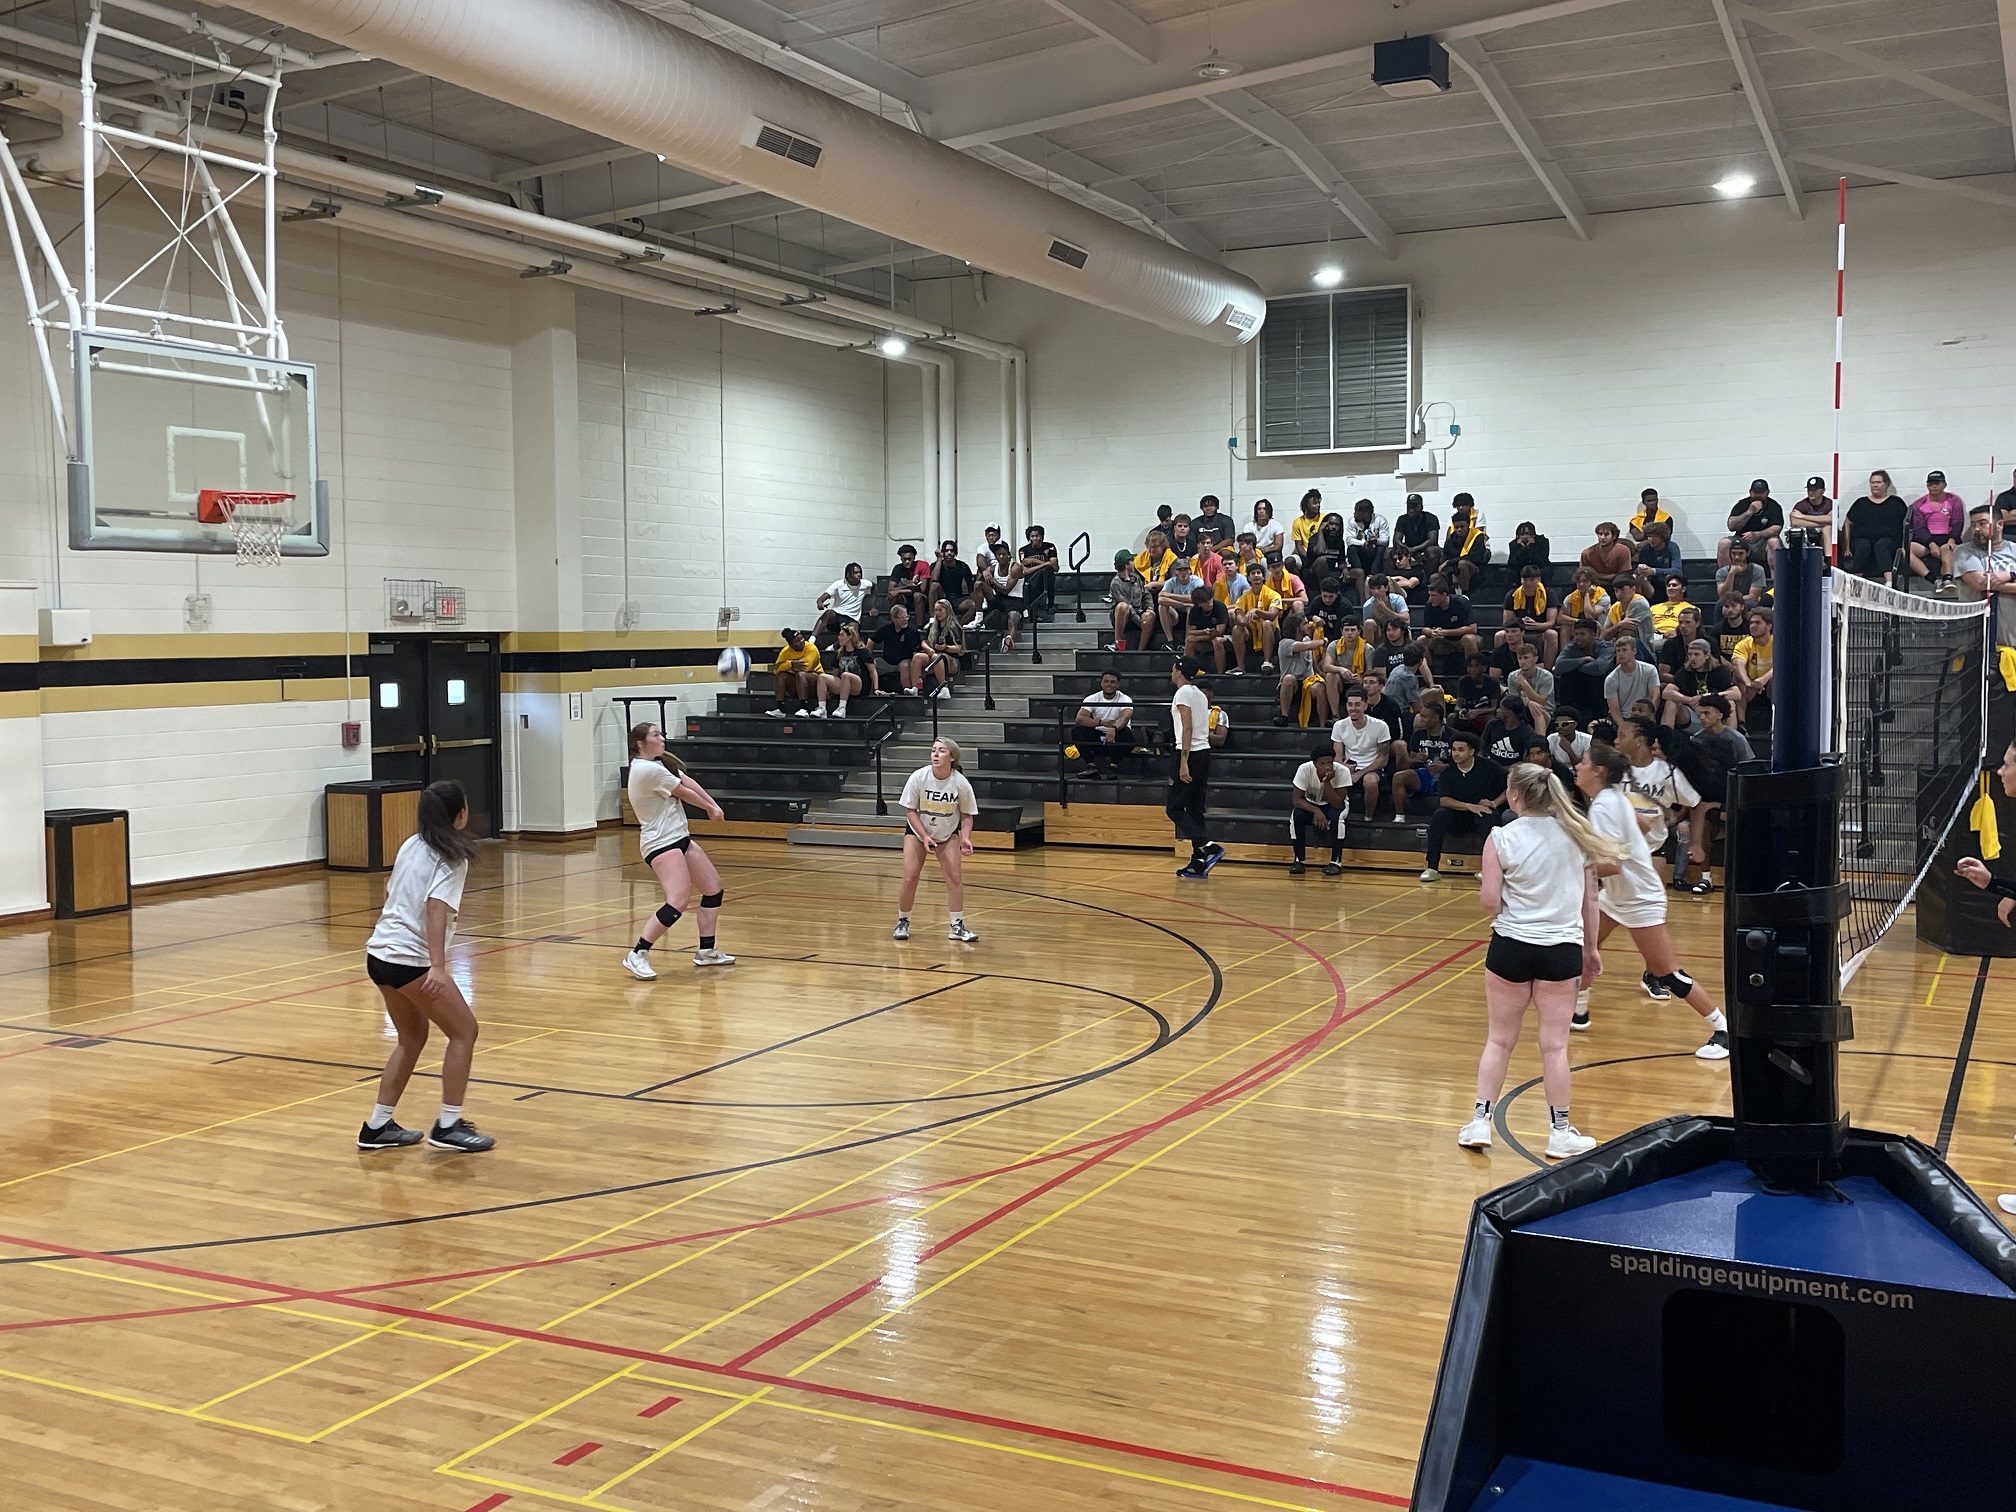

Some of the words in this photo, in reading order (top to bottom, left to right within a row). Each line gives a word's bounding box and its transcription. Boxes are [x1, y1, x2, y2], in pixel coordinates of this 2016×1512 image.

[441, 598, 456, 615] EXIT
[924, 789, 960, 803] TEAM
[1621, 780, 1666, 798] TEAM
[1609, 1252, 1914, 1310] spaldingequipment.com
